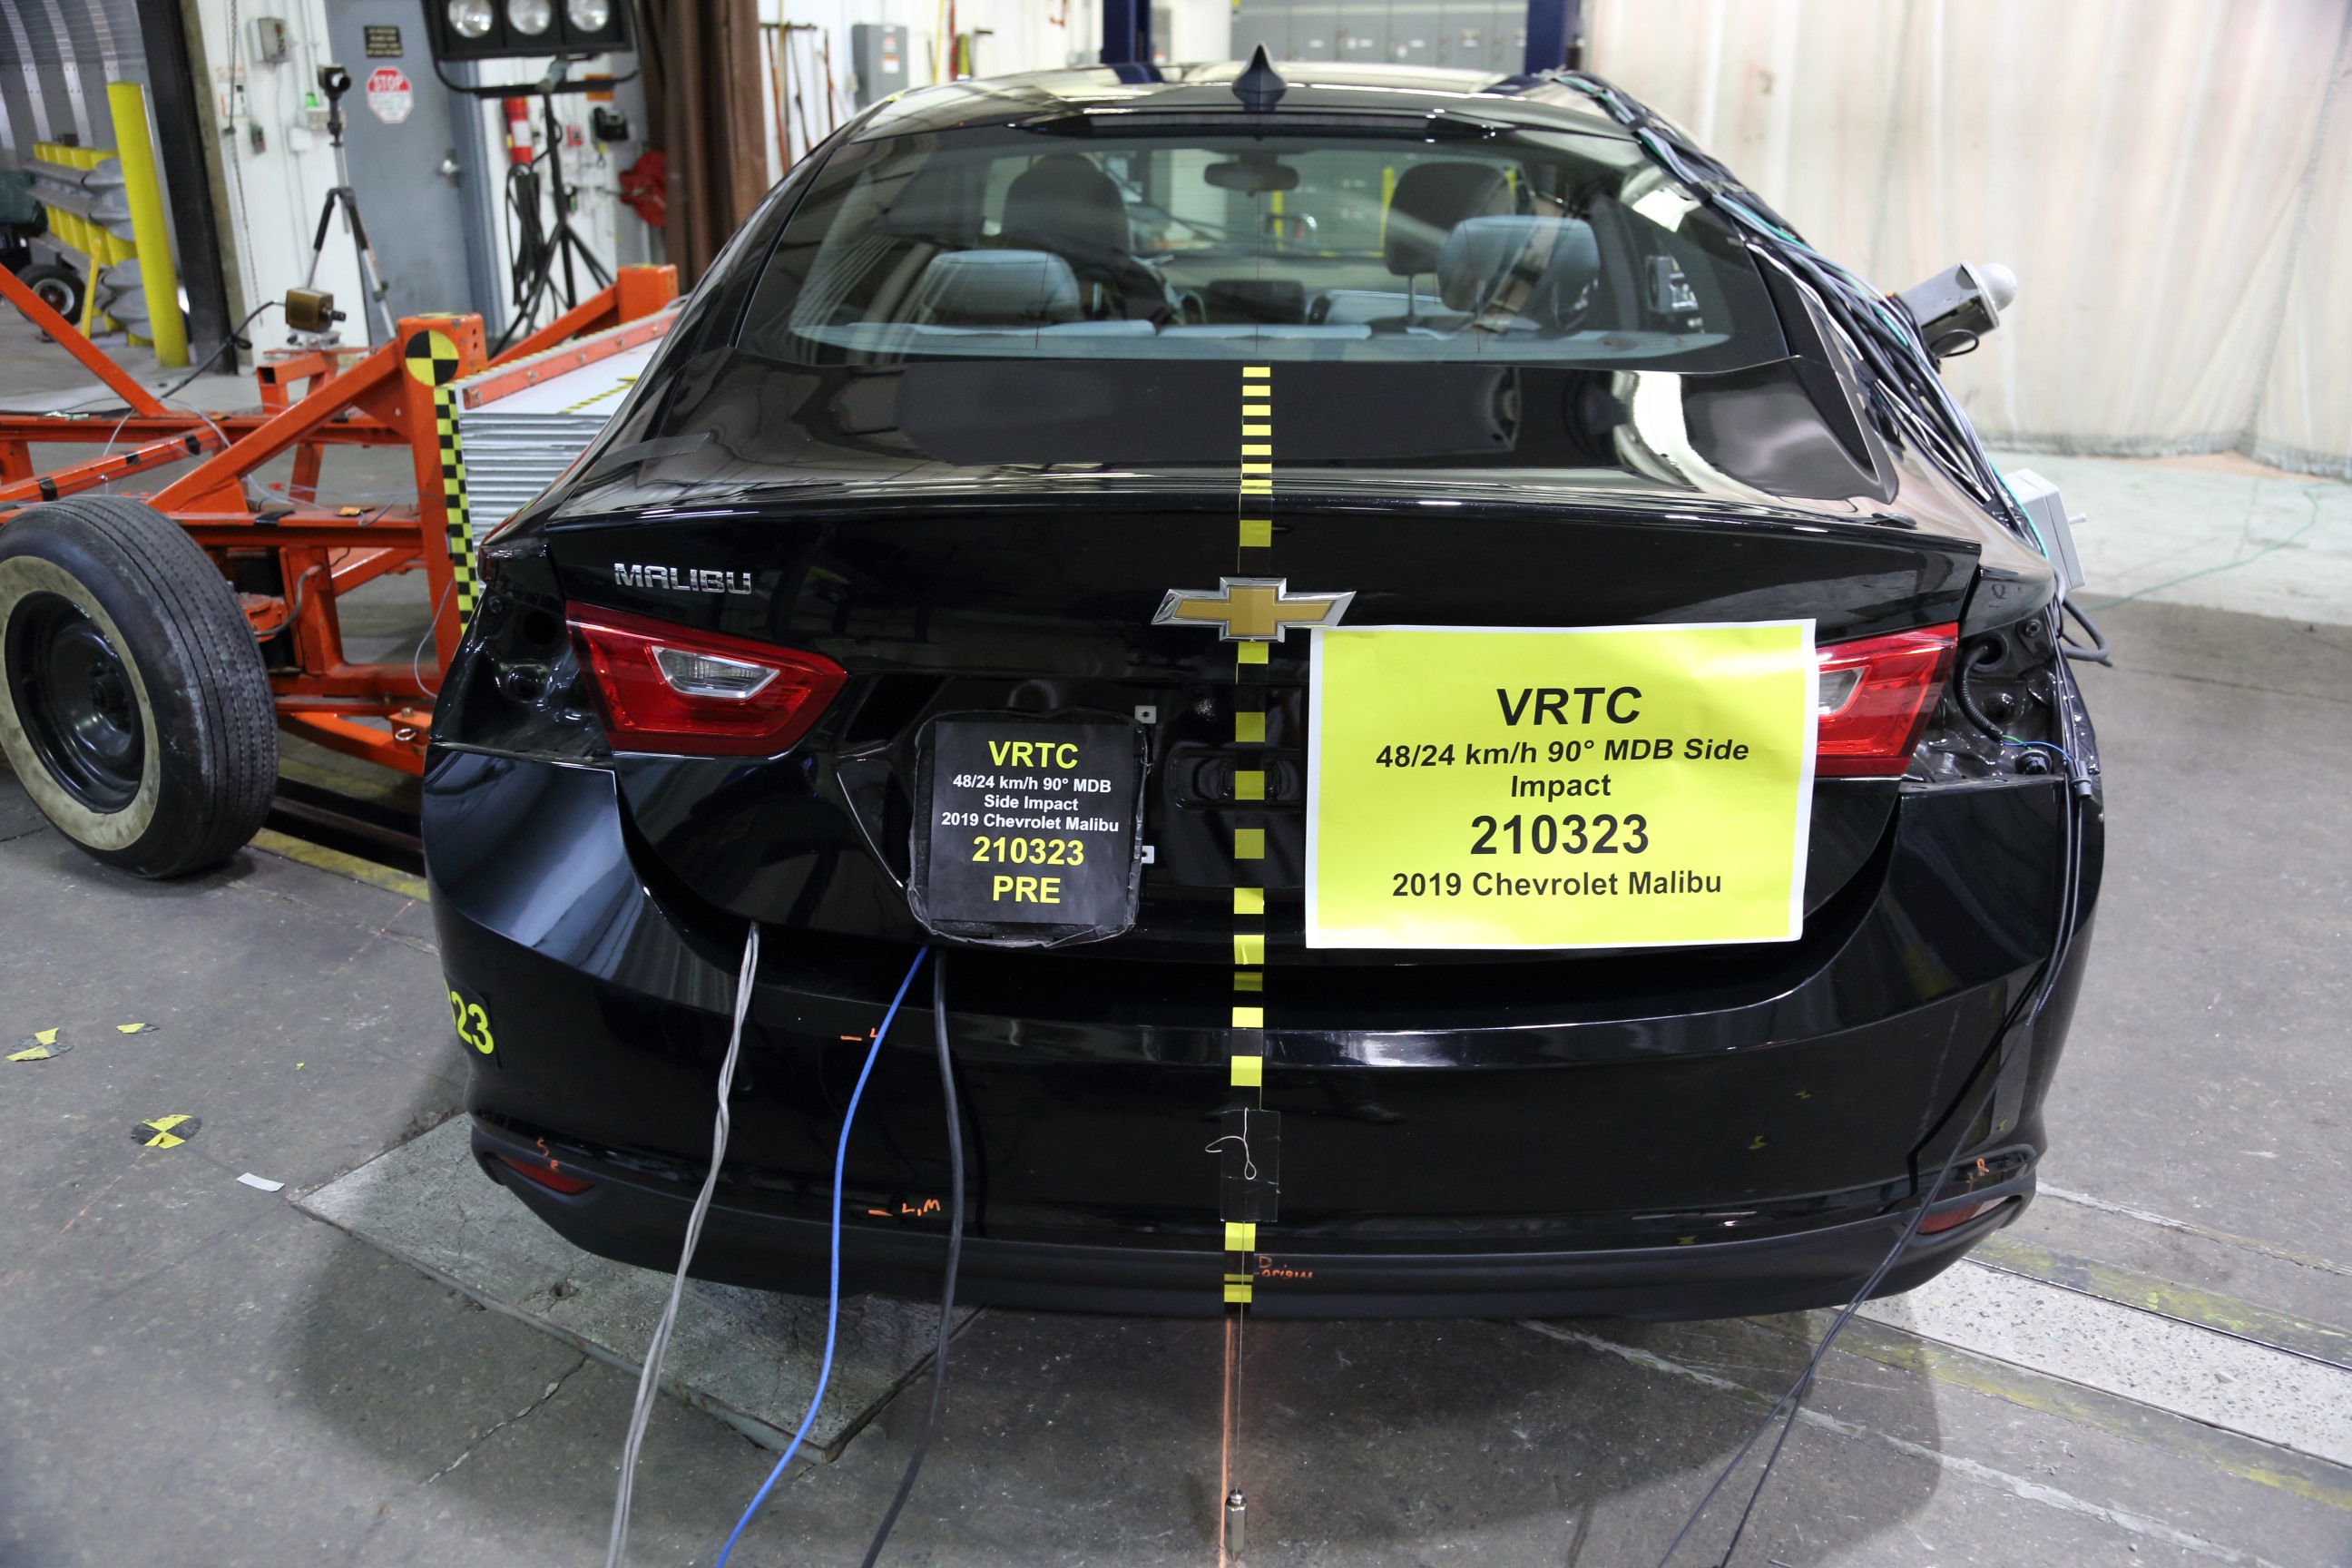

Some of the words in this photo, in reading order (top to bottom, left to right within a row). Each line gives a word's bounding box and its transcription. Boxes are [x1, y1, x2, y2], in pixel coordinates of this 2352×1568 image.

[373, 74, 405, 93] STOP
[614, 563, 752, 595] MALIBU
[1496, 686, 1642, 726] VRTC
[988, 740, 1079, 769] VRTC
[1376, 744, 1455, 768] 48/24
[1465, 742, 1537, 764] km/h
[1548, 740, 1595, 763] 90°
[1604, 739, 1674, 760] MDB
[1683, 738, 1749, 760] Side
[953, 774, 995, 789] 48/24
[999, 776, 1038, 790] km/h
[1043, 778, 1069, 791] 90°
[1073, 778, 1112, 793] MDB
[1511, 773, 1612, 802] Impact
[984, 794, 1019, 809] Side
[1024, 796, 1079, 813] Impact
[941, 811, 979, 827] 2019
[983, 813, 1061, 830] Chevrolet
[1065, 817, 1120, 832] Malibu
[1470, 813, 1649, 855] 210323
[972, 836, 1084, 867] 210323
[993, 875, 1061, 904] PRE
[1392, 872, 1462, 897] 2019
[1473, 871, 1618, 897] Chevrolet
[1629, 869, 1722, 895] Malibu
[445, 979, 495, 1054] 23
